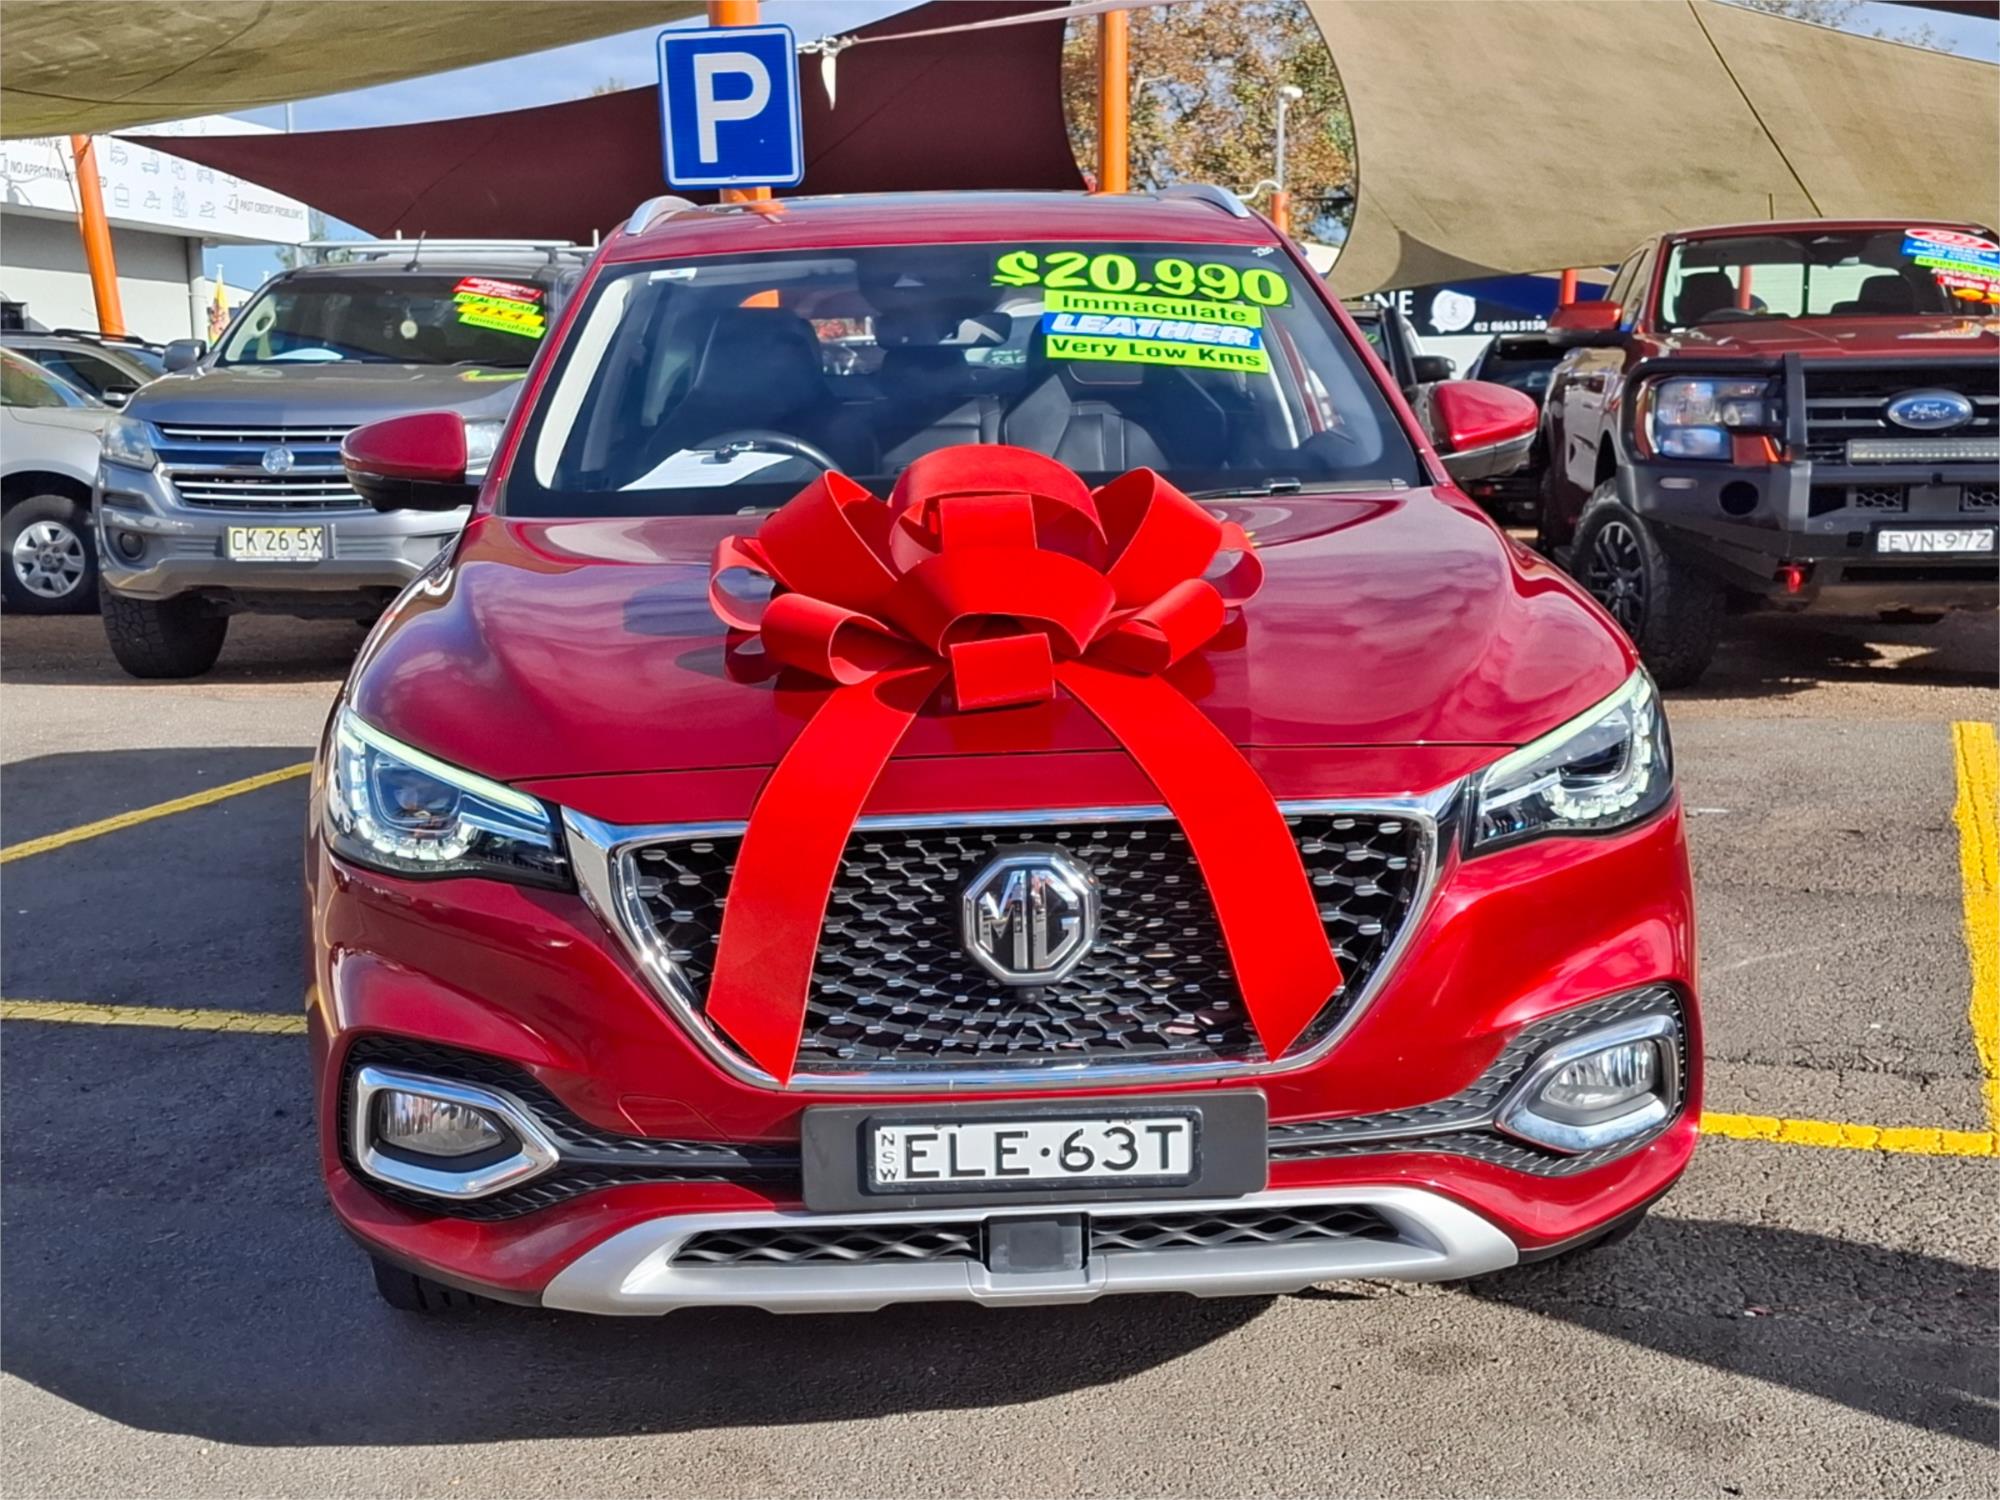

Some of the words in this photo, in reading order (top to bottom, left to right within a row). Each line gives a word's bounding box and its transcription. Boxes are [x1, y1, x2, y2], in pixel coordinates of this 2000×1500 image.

[693, 51, 772, 164] P
[1063, 294, 1247, 323] Immaculate
[1050, 312, 1254, 347] LEATHER
[1052, 337, 1118, 359] Very
[1129, 342, 1188, 361] Low
[1199, 350, 1262, 367] Kms
[232, 528, 257, 551] CK
[266, 529, 290, 551] 26
[297, 528, 323, 551] SX
[979, 870, 1081, 970] MG
